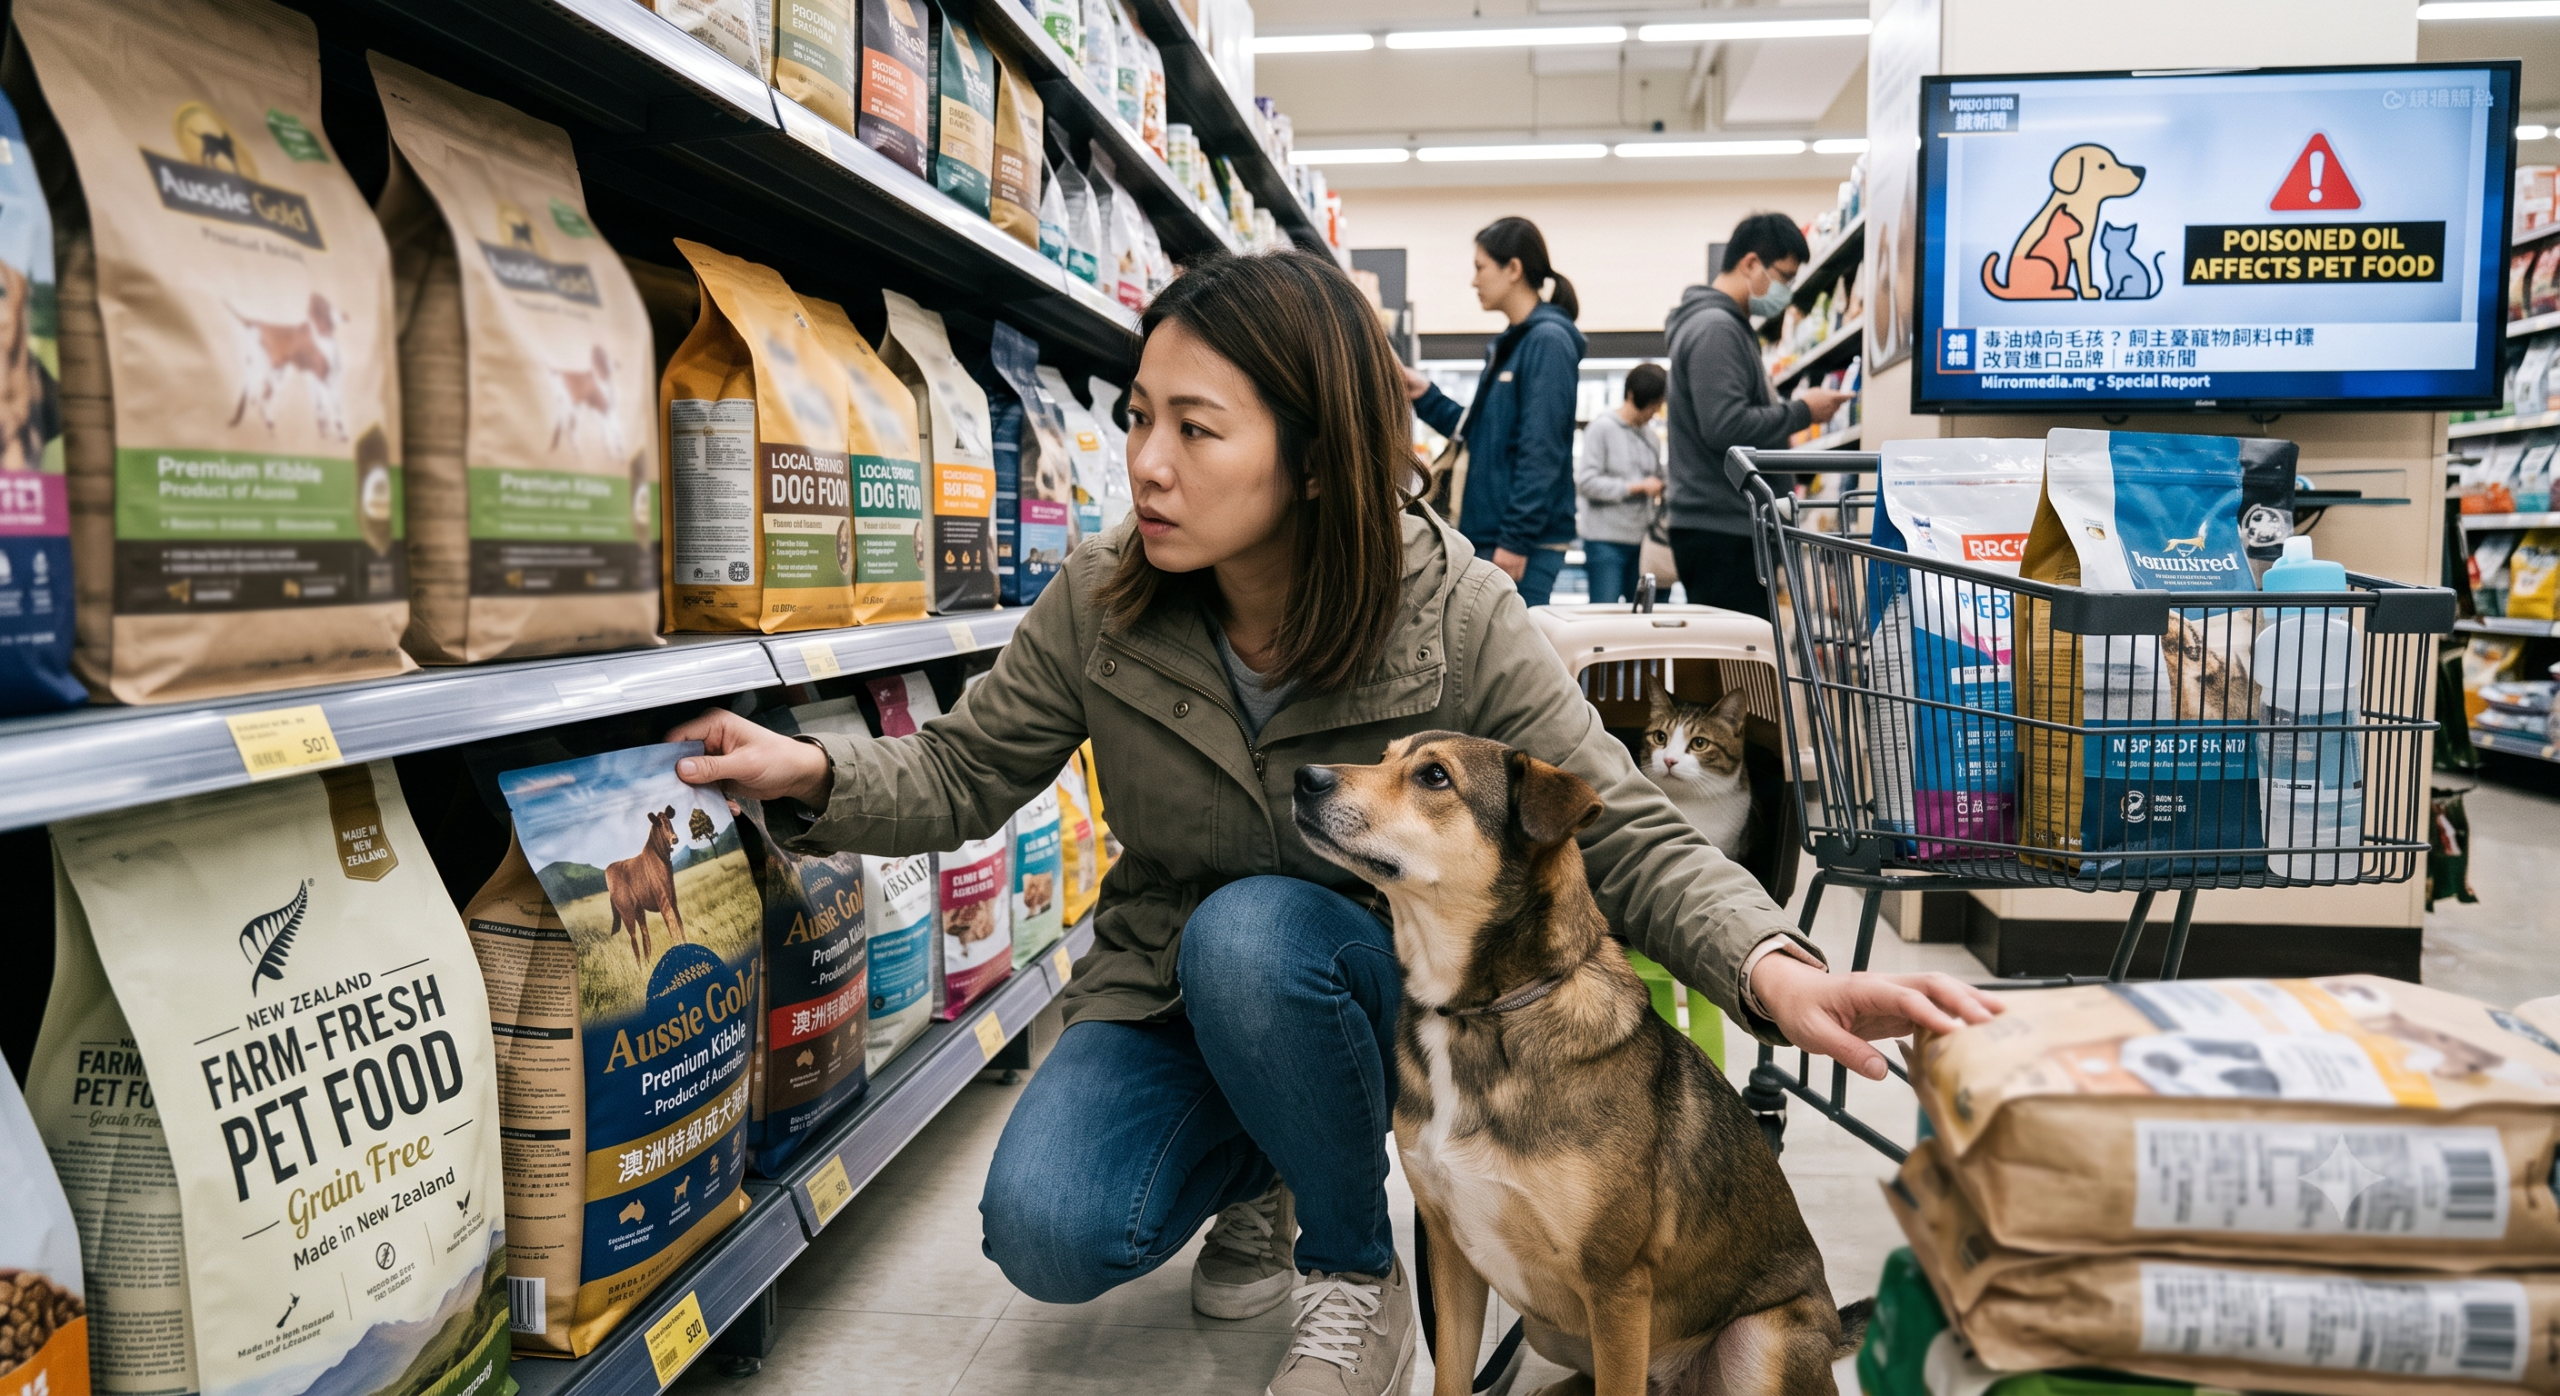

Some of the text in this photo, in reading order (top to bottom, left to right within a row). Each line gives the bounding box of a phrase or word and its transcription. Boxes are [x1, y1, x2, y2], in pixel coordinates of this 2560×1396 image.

[2223, 228, 2404, 252] POISONED OIL
[2190, 255, 2435, 280] AFFECTS PET FOOD
[1981, 374, 2096, 391] Mirrormedia.mg
[2106, 374, 2158, 390] Special
[2161, 374, 2211, 390] Report
[158, 456, 260, 480] Premium
[772, 453, 813, 471] LOCAL
[859, 464, 892, 479] LOCAL
[772, 474, 814, 505] DOG
[860, 481, 894, 509] DOG
[346, 848, 388, 867] ZEALAND
[834, 878, 864, 929] Gol
[246, 971, 373, 1031] NEW ZEALAND
[603, 957, 758, 1074] Aussie Gold
[201, 973, 446, 1111] FARM-FRESH
[641, 1019, 746, 1096] Premium Kibble
[73, 1077, 122, 1107] PET
[654, 1083, 698, 1116] Product
[699, 1069, 710, 1093] of
[88, 1109, 162, 1129] Grain Free
[220, 1029, 464, 1203] PET FOOD
[288, 1135, 435, 1240] Grain Free
[293, 1166, 456, 1271] Made in New Zealand
